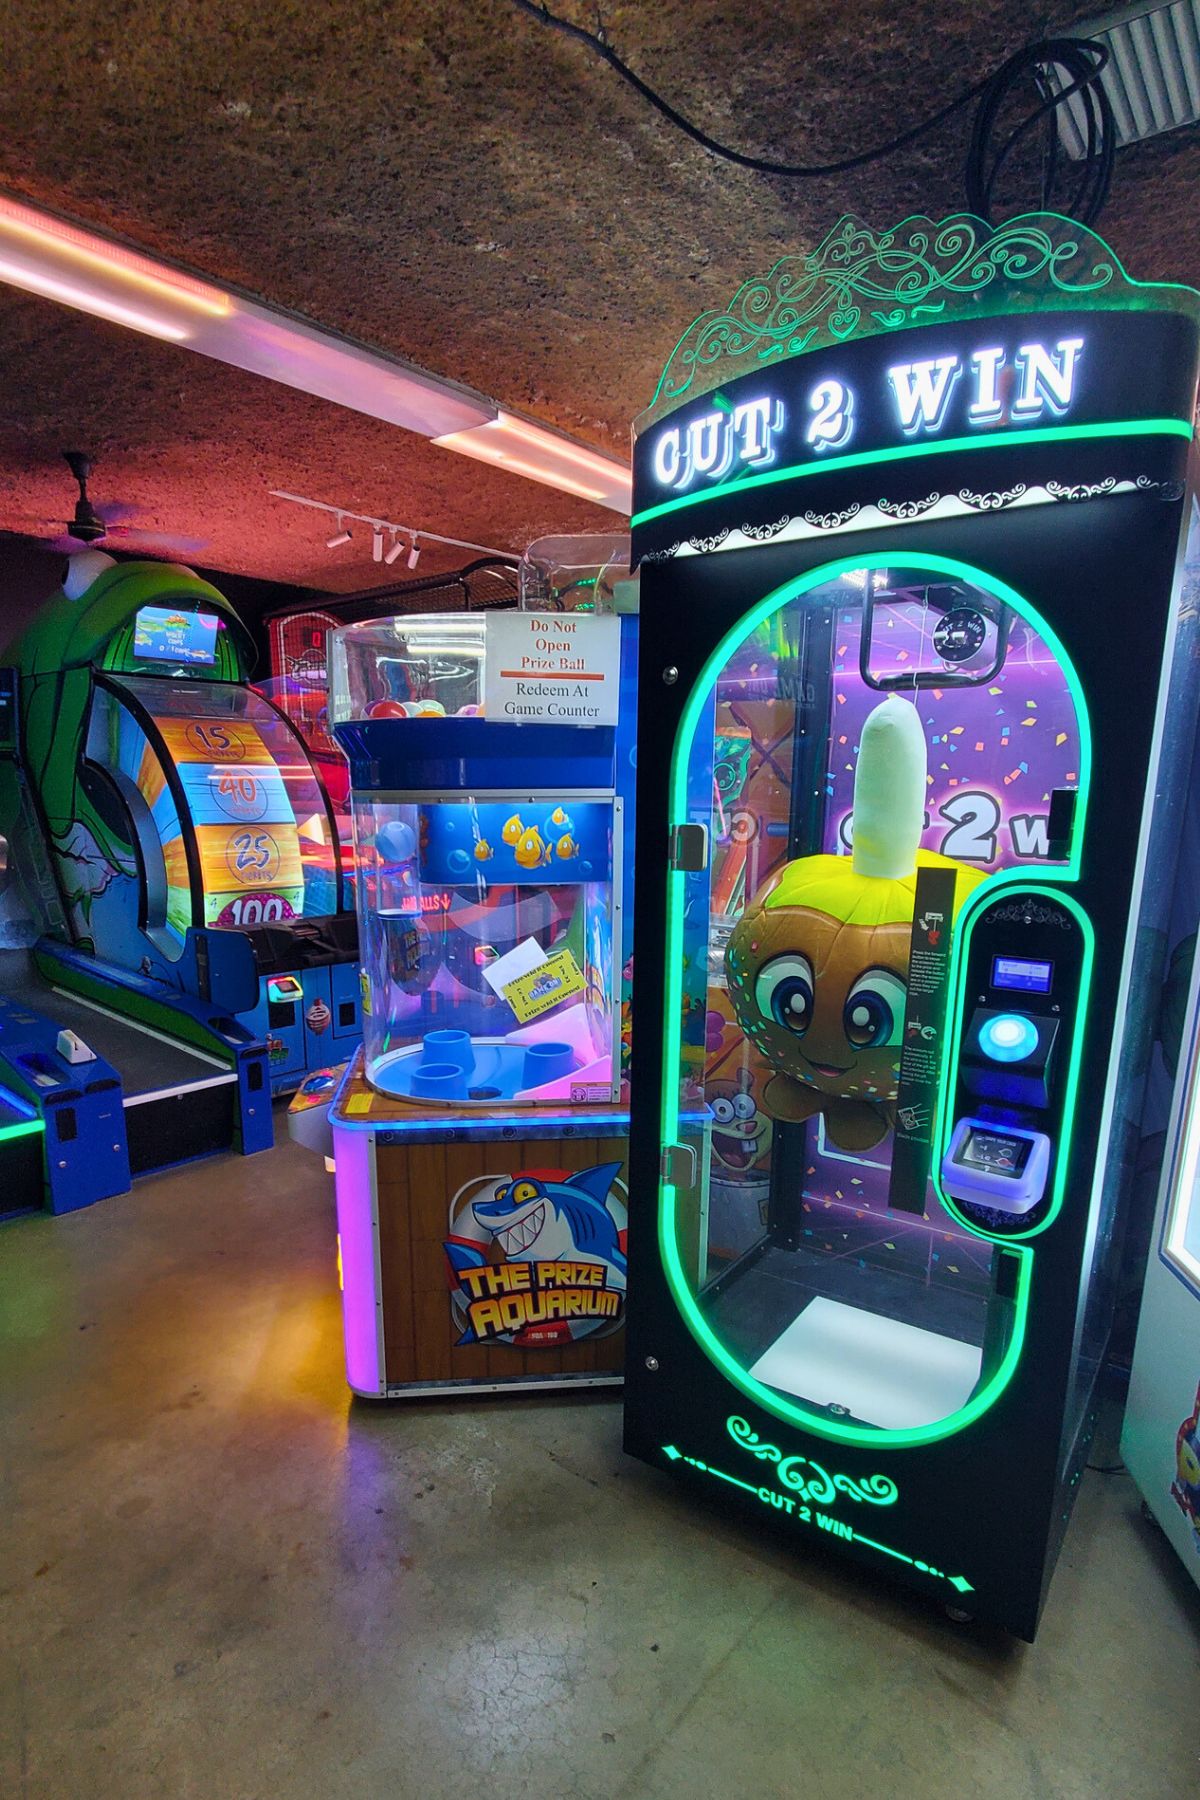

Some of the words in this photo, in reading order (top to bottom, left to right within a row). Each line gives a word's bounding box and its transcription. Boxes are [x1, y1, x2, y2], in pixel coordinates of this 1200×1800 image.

[654, 397, 780, 488] CUT
[809, 380, 853, 451] 2
[887, 338, 1083, 433] WIN
[530, 620, 548, 632] Do
[553, 620, 577, 633] Not
[535, 638, 571, 653] Open
[521, 656, 555, 669] Prize
[560, 658, 585, 670] Ball
[516, 683, 569, 697] Redeem
[573, 685, 588, 697] At
[504, 702, 543, 715] Game
[547, 703, 600, 717] Counter
[195, 725, 231, 750] 15
[218, 771, 256, 804] 40
[939, 790, 1001, 863] 2
[234, 833, 270, 870] 25
[232, 898, 282, 926] 100
[458, 1262, 531, 1298] THE
[537, 1263, 604, 1287] PRIZE
[469, 1289, 620, 1338] AQUARIUM
[756, 1487, 795, 1514] CUT
[799, 1505, 811, 1522] 2
[816, 1512, 853, 1542] WIN
